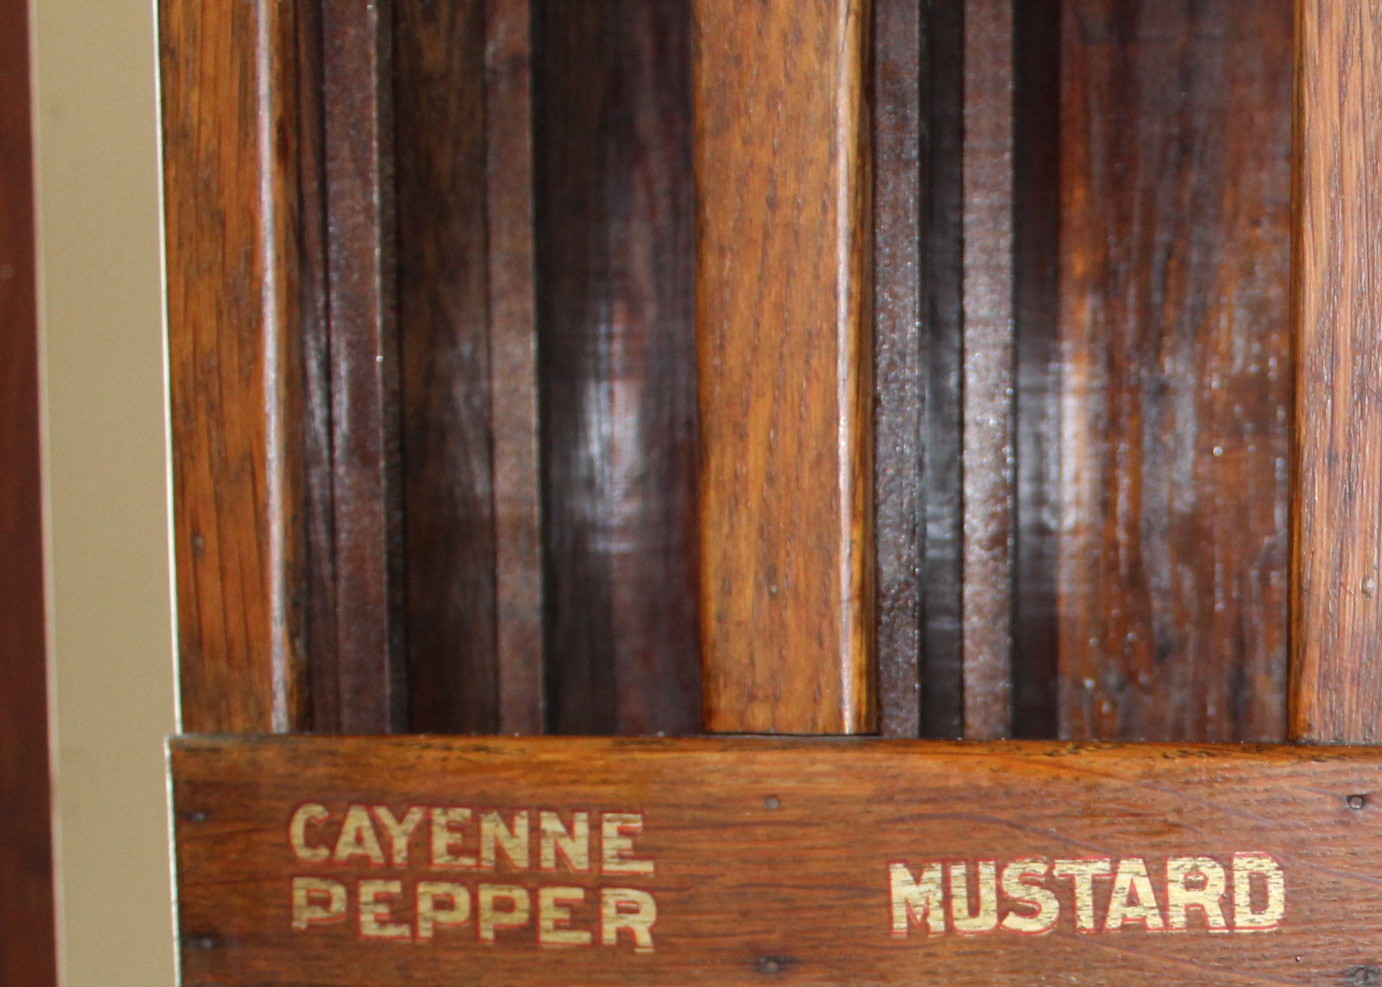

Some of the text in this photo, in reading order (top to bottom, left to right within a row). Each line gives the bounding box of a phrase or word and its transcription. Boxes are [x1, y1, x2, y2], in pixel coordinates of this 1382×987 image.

[289, 804, 656, 875] CAYENNE
[290, 877, 658, 953] PEPPER
[888, 851, 1288, 938] MUSTARD
